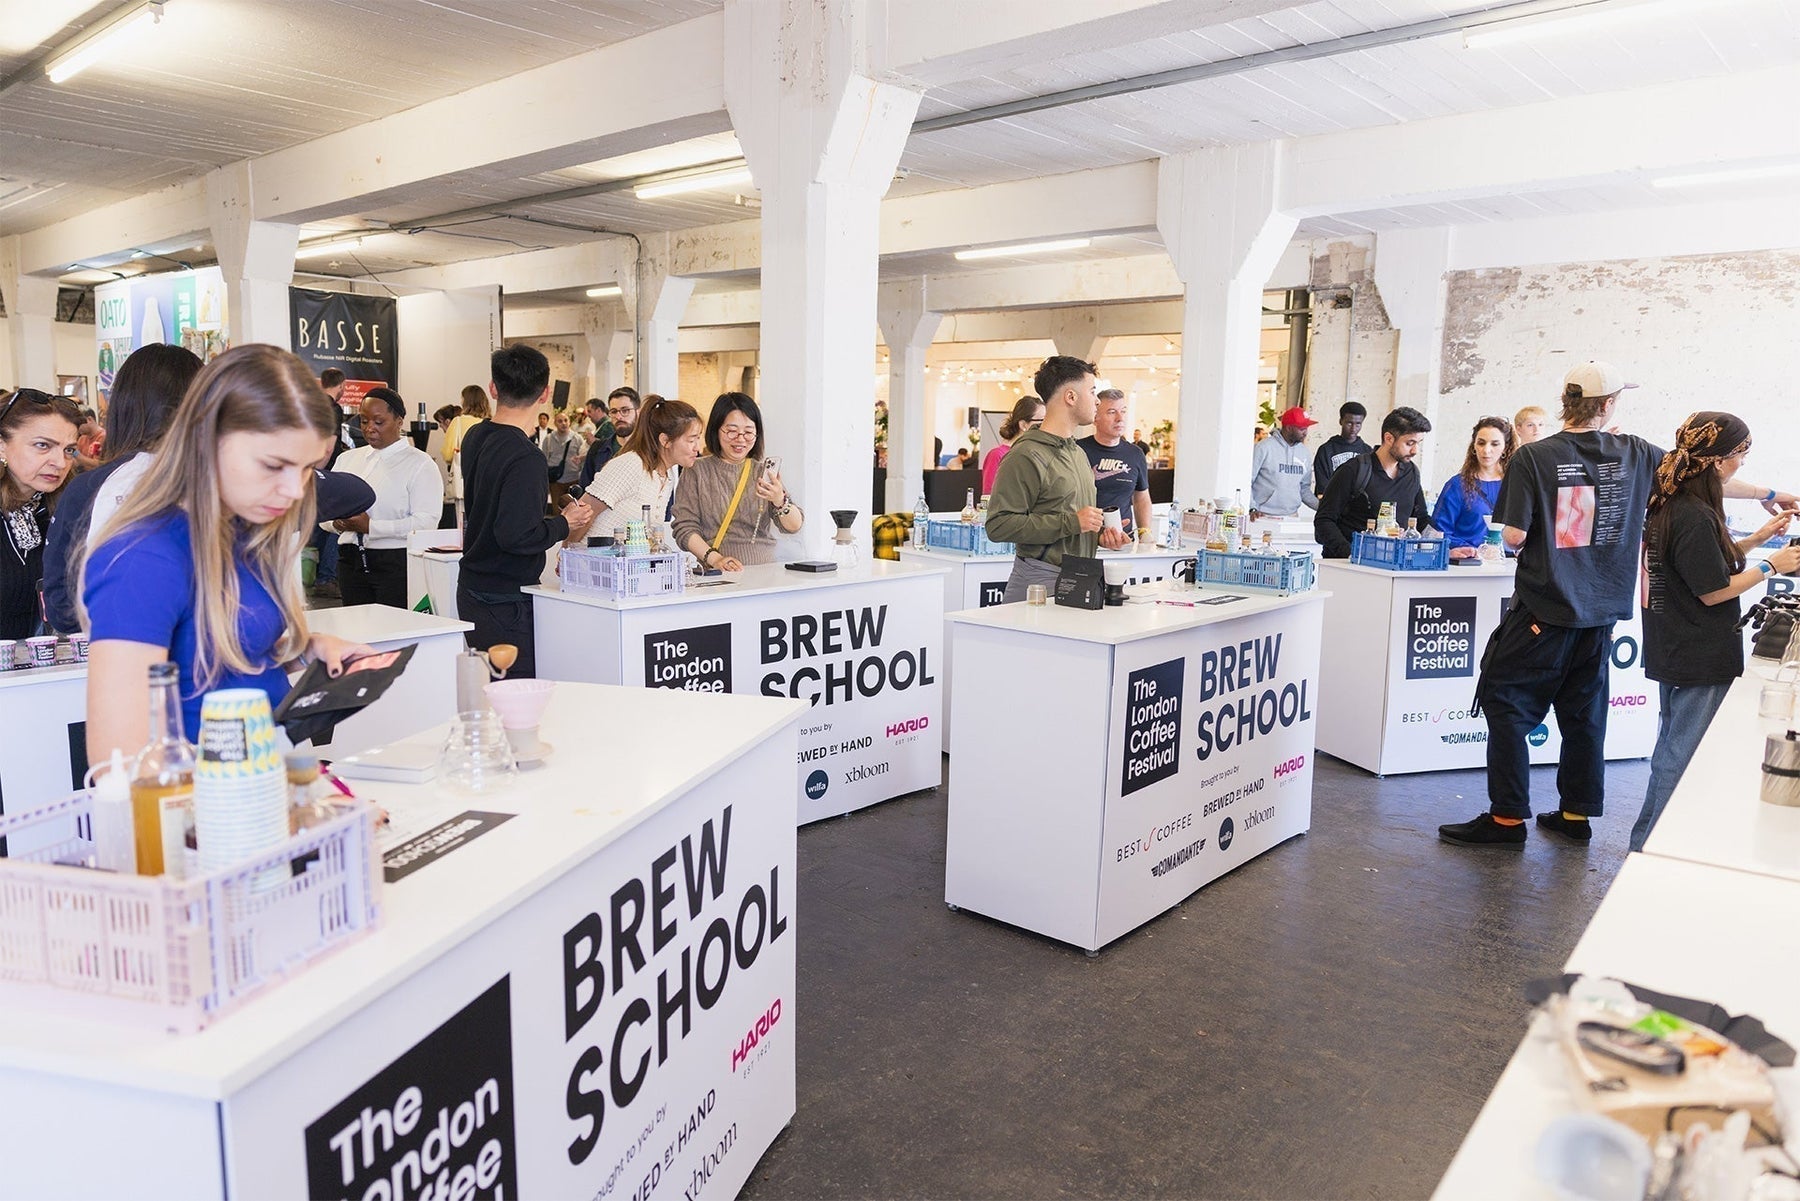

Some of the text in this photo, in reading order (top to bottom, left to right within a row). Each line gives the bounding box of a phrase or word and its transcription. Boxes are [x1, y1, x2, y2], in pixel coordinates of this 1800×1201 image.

[1098, 458, 1124, 471] NIKE
[1278, 463, 1304, 475] PUMA
[986, 588, 1004, 603] Th
[1415, 604, 1443, 619] The
[760, 604, 888, 665] BREW
[1414, 619, 1470, 635] London
[653, 640, 688, 661] The
[1413, 635, 1470, 654] Coffee
[654, 656, 724, 683] London
[1200, 632, 1283, 703] BREW
[1412, 653, 1469, 671] Festival
[760, 647, 935, 708] SCHOOL
[1133, 678, 1157, 702] The
[1131, 695, 1178, 727] London
[1608, 695, 1648, 707] HARIO
[800, 722, 833, 736] to you by
[886, 716, 929, 739] HARIO
[1196, 678, 1311, 762] SCHOOL
[1402, 712, 1430, 723] BEST
[1130, 719, 1177, 754] Coffee
[1449, 731, 1488, 744] COMANDA
[797, 736, 873, 764] WED BY HAND
[1128, 742, 1175, 781] Festival
[844, 761, 890, 785] xbloom
[1201, 774, 1219, 789] Brought
[1225, 767, 1234, 777] you
[1273, 755, 1305, 779] HARIO
[807, 782, 827, 793] wilfa
[1203, 791, 1235, 817] BREWED
[1243, 777, 1265, 798] HAND
[1244, 806, 1276, 831] xbloom
[1116, 813, 1193, 862] BEST COFFEE
[1157, 840, 1202, 877] COMANDANTE
[562, 803, 733, 1044] BREW
[565, 864, 788, 1166] SCHOOL
[732, 998, 782, 1074] HARIO
[743, 1059, 754, 1080] EST
[329, 1085, 423, 1187] The
[344, 1077, 500, 1201] ondon
[664, 1141, 675, 1165] BY
[678, 1088, 716, 1153] HAND
[590, 1101, 668, 1201] ought to you by
